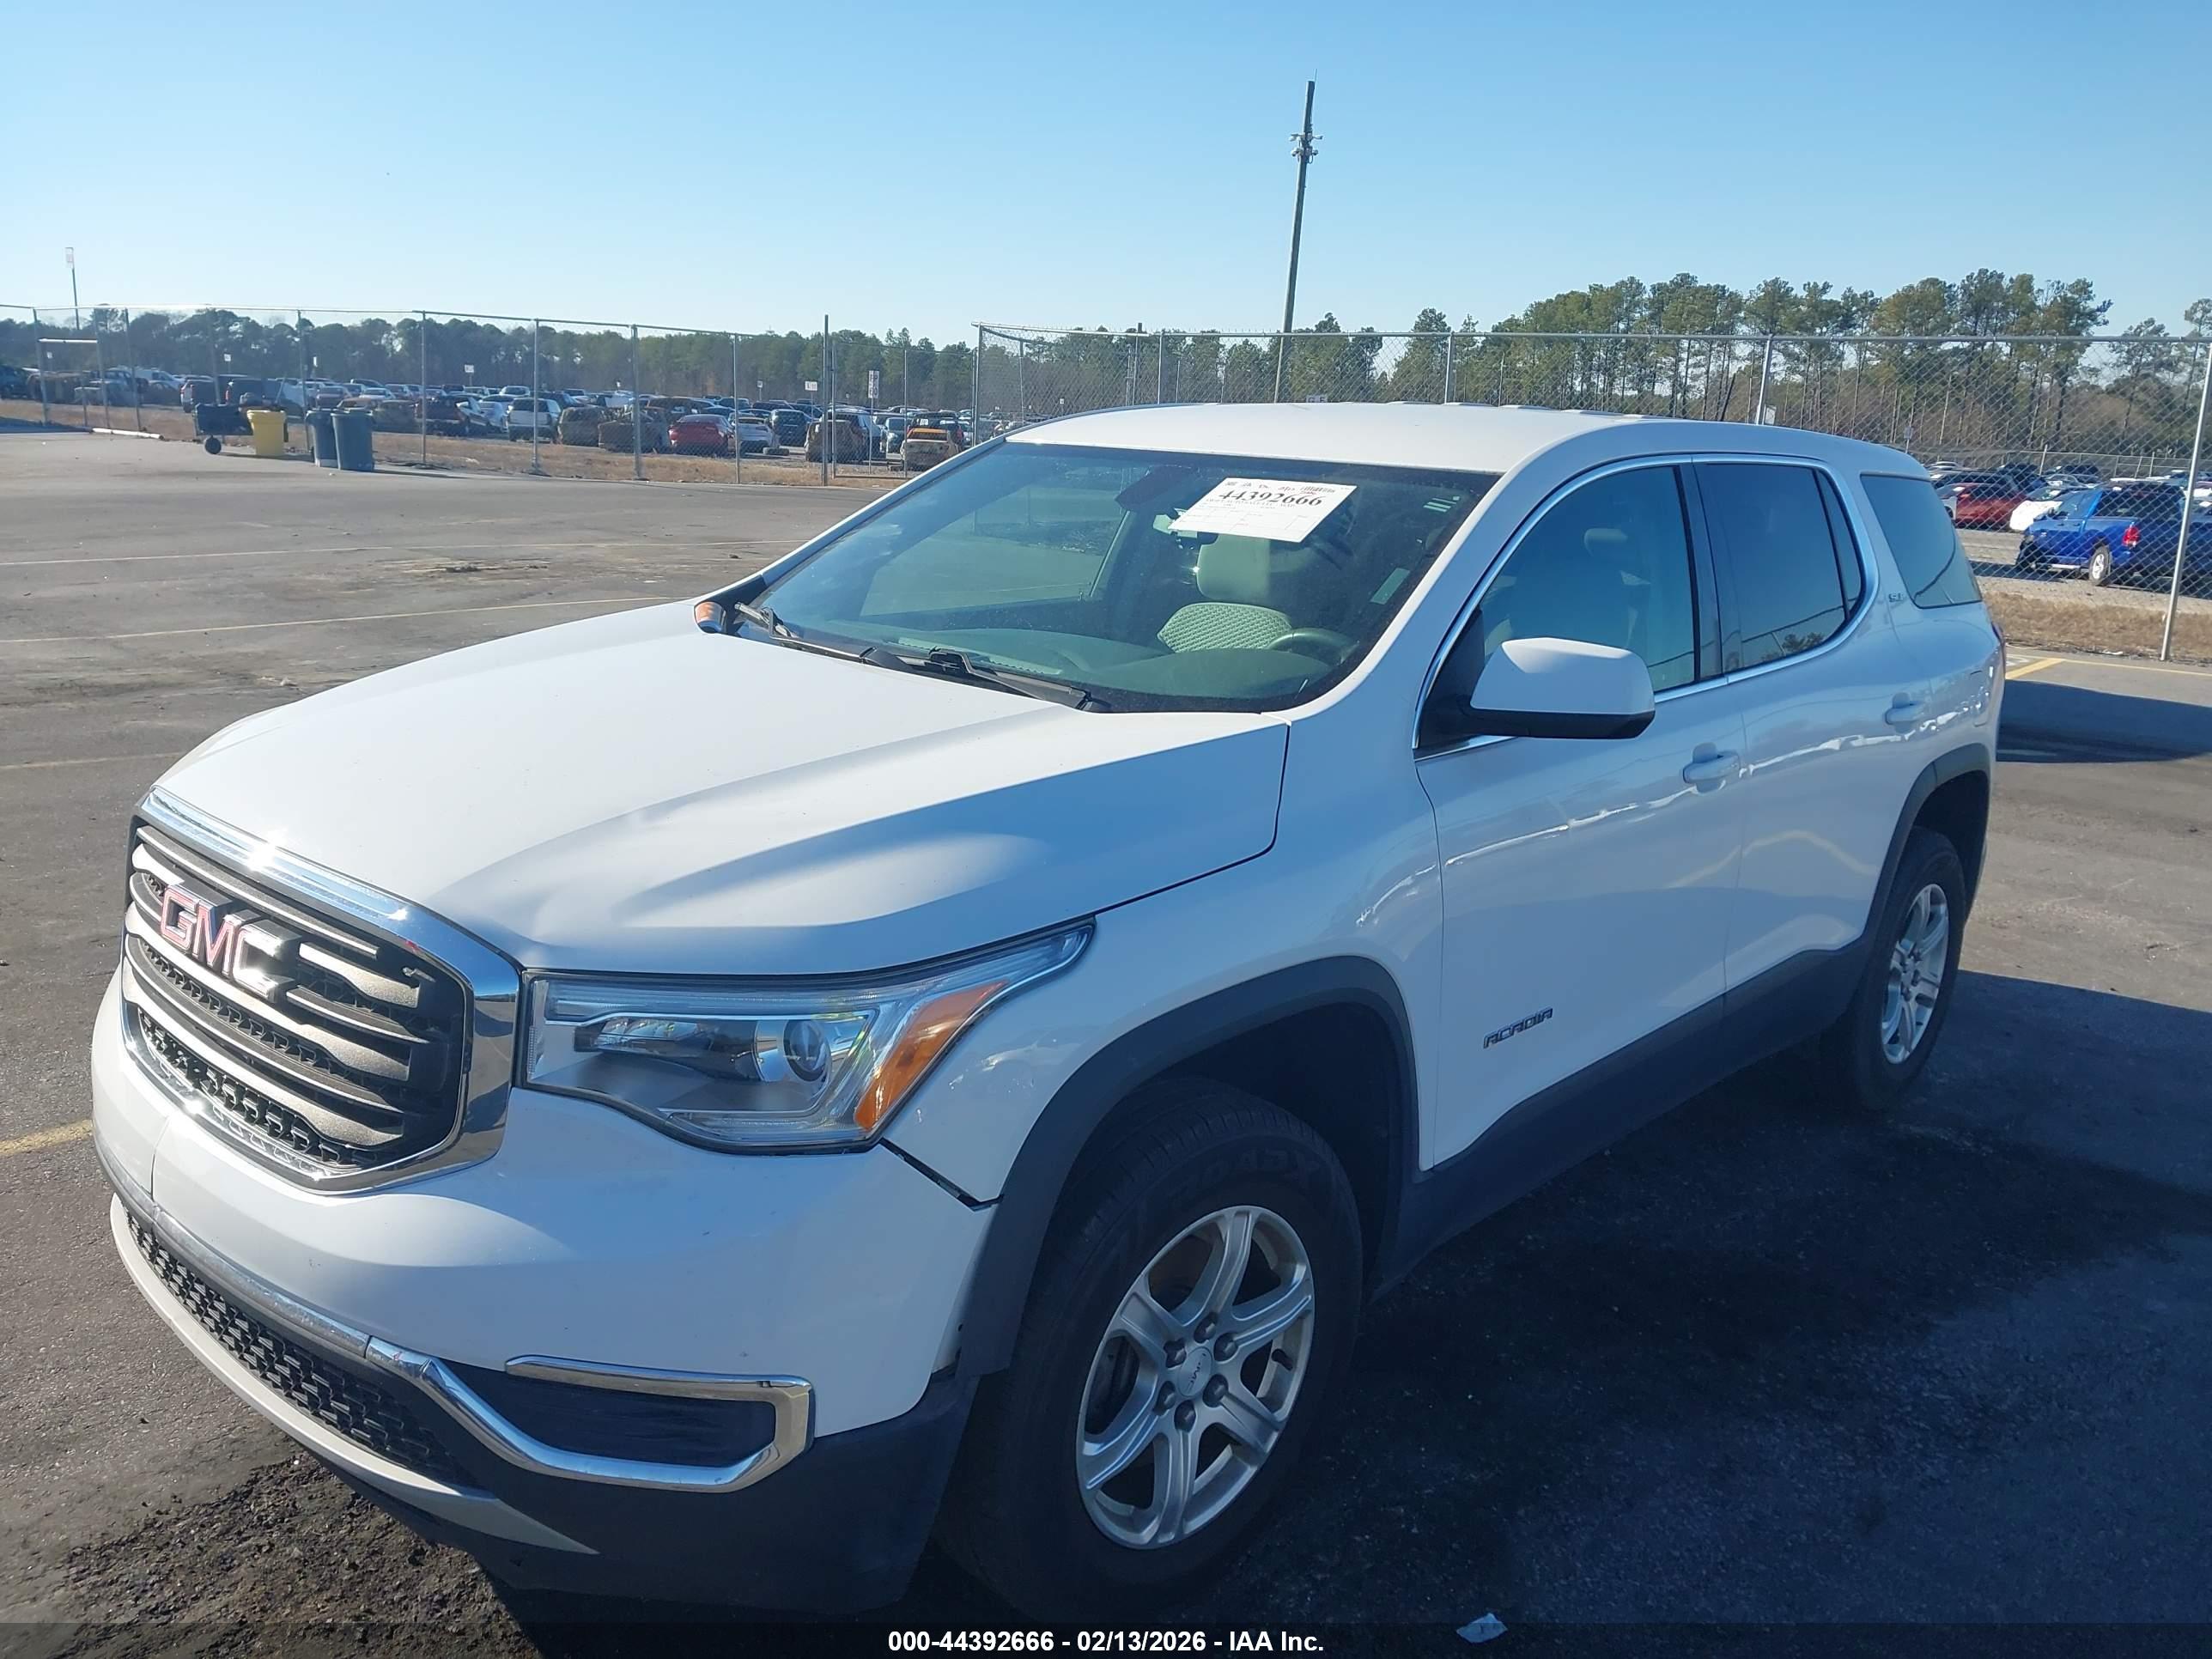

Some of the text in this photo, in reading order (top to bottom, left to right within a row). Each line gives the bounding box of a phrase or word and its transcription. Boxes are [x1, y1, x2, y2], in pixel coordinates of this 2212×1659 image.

[1218, 489, 1326, 507] 44392666
[160, 884, 285, 1003] GMC
[1483, 1006, 1553, 1049] ACADIA
